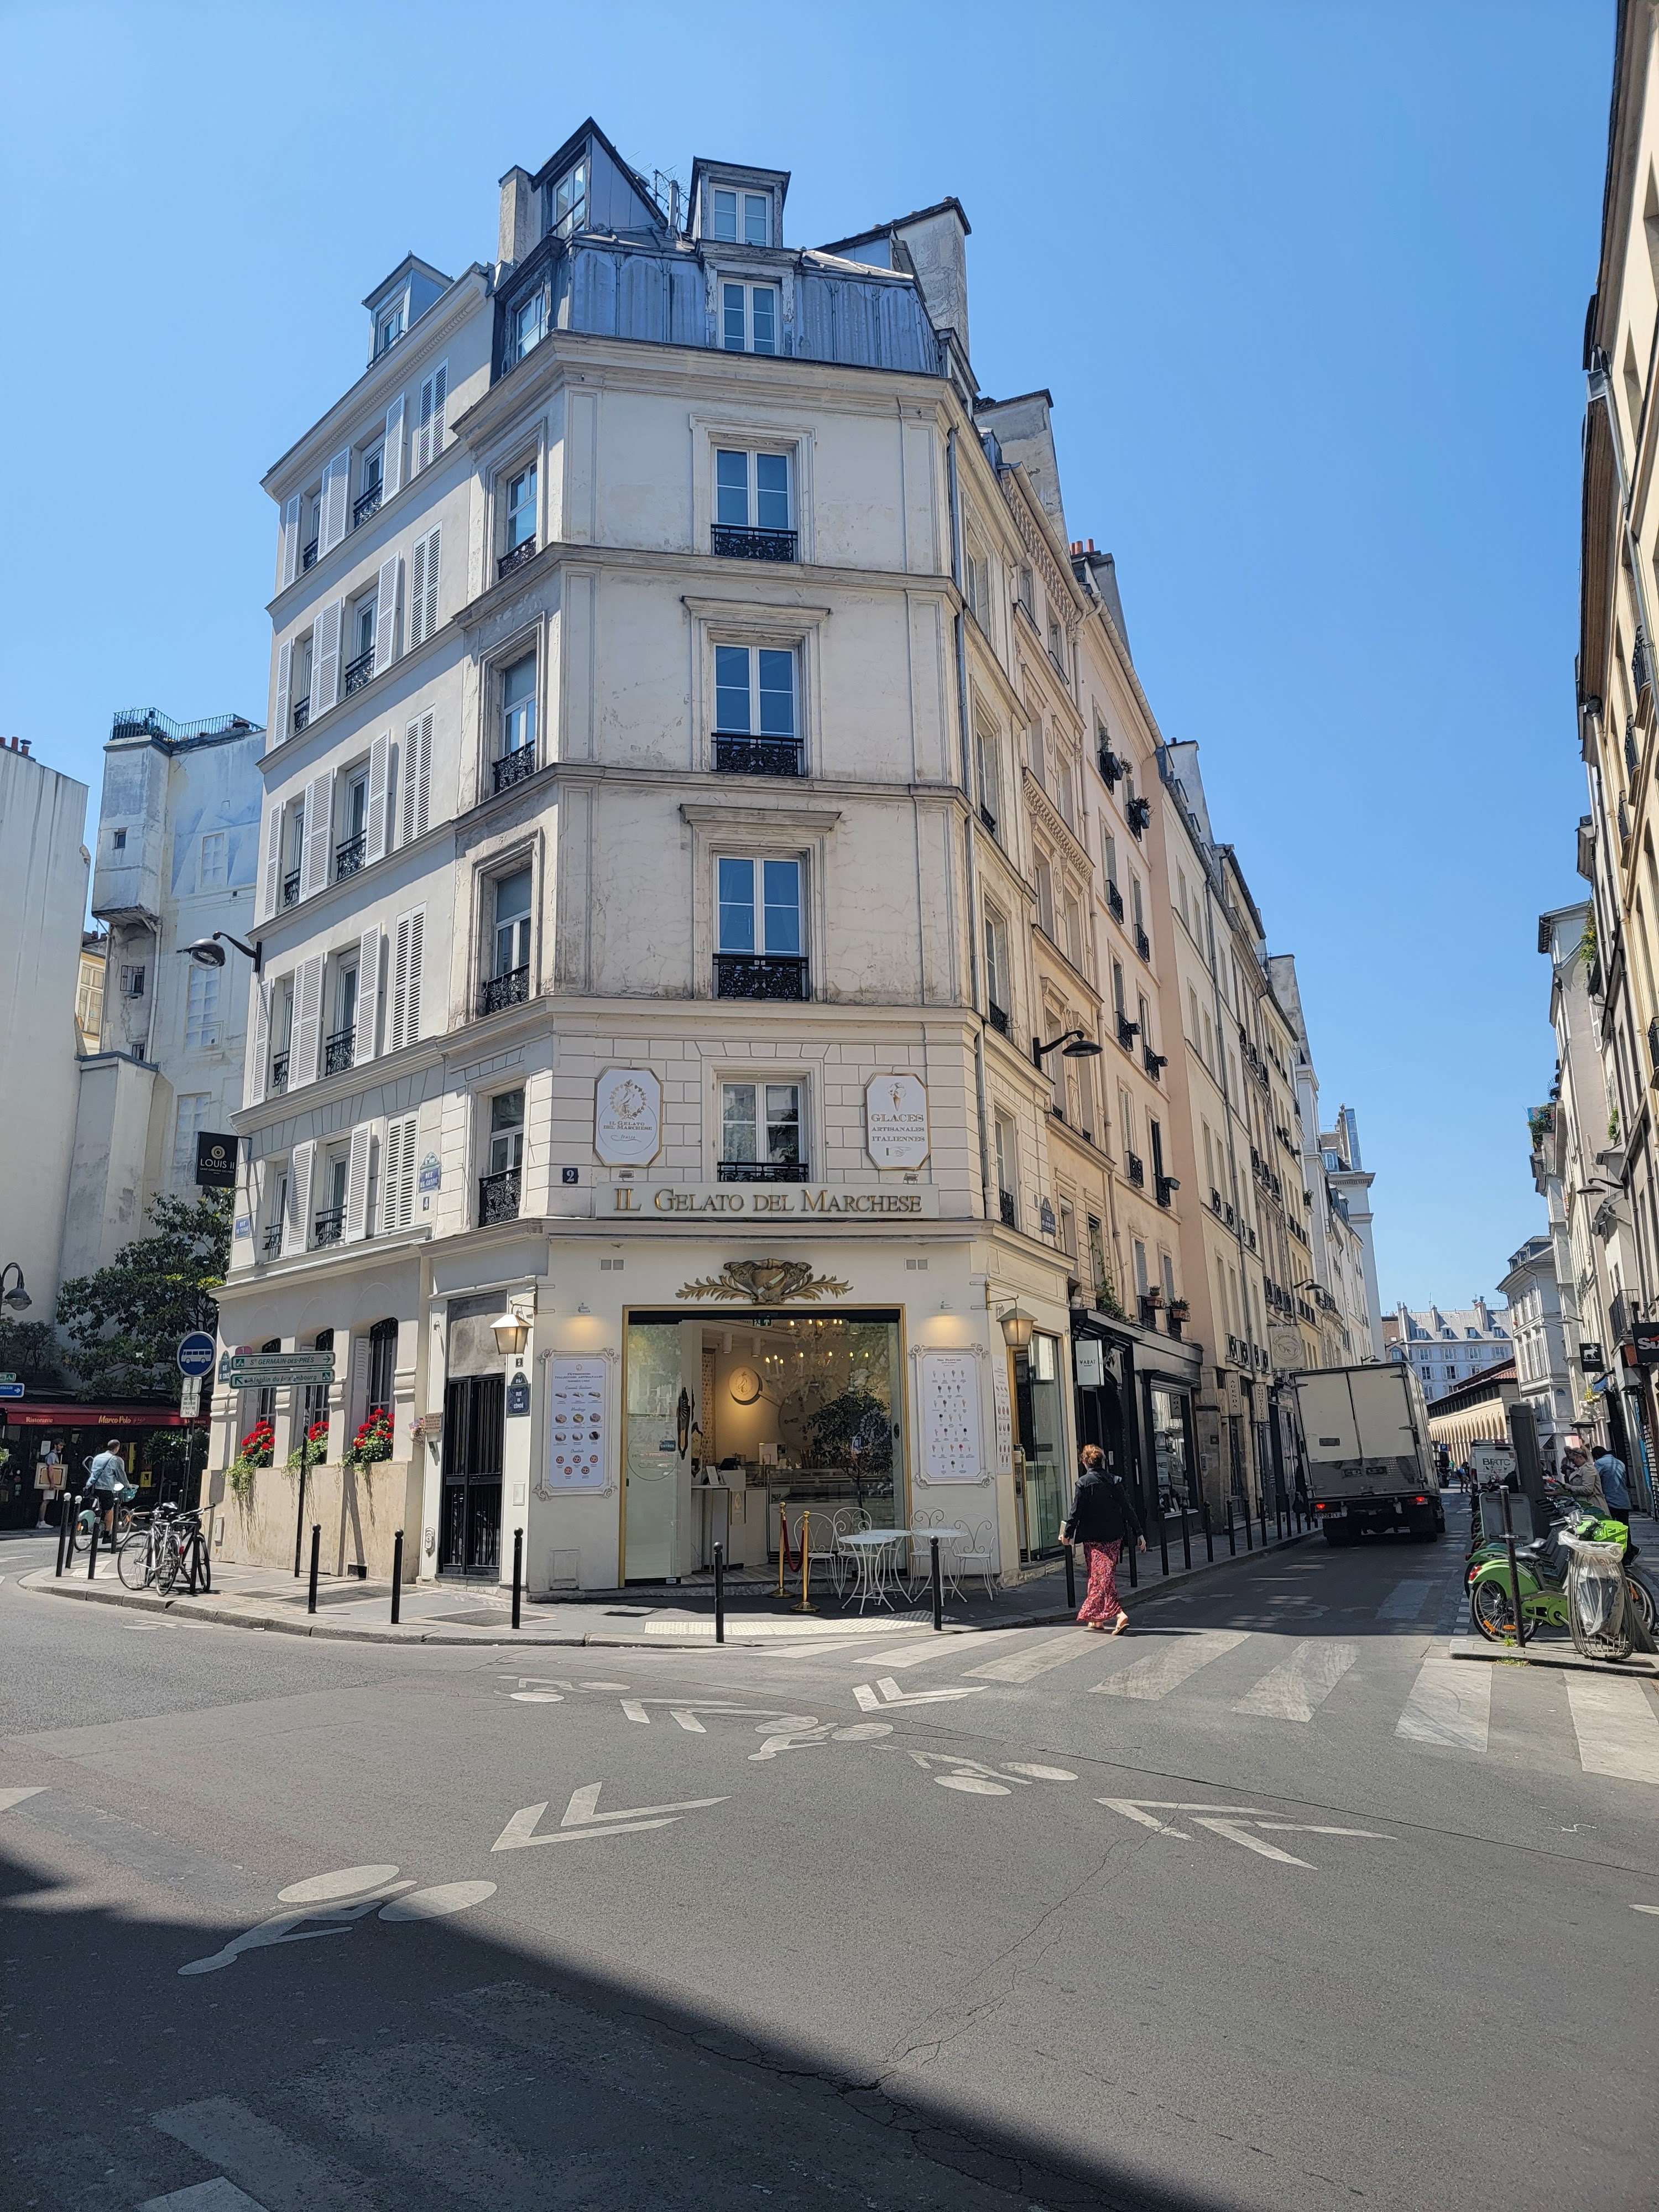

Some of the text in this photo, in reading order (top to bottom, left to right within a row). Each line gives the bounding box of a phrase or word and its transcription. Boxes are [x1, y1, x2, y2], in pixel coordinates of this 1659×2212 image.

[871, 1114, 924, 1123] GLACES
[200, 1158, 227, 1168] LOUIS
[566, 1170, 575, 1182] 2
[424, 1197, 429, 1209] 4
[613, 1188, 922, 1212] IL GELATO DEL MARCHESE
[98, 1415, 118, 1424] Marco
[119, 1415, 132, 1424] Polo
